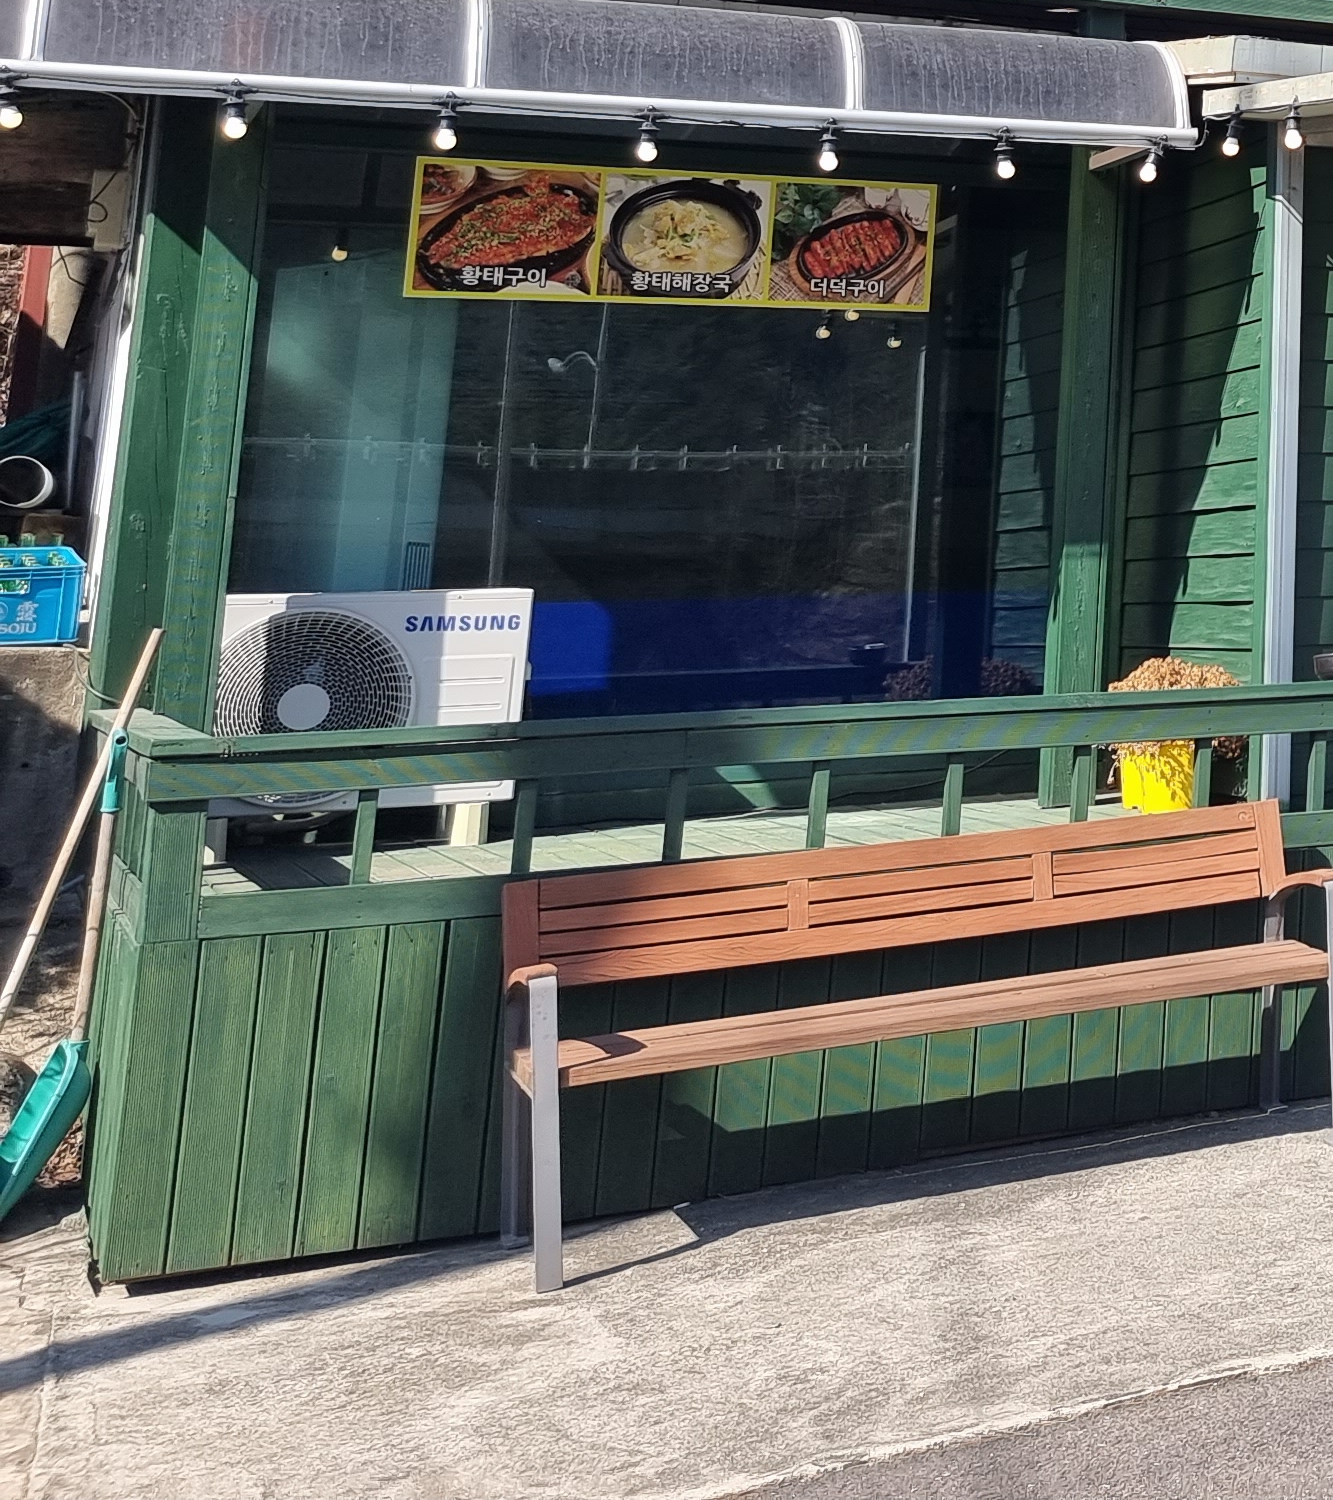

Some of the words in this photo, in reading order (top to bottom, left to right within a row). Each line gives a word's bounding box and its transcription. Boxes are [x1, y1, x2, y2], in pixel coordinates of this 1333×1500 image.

[461, 266, 547, 288] 황태구이
[630, 271, 733, 294] 황태해장국
[809, 277, 886, 299] 더덕구이
[404, 613, 522, 633] SAMSUNG
